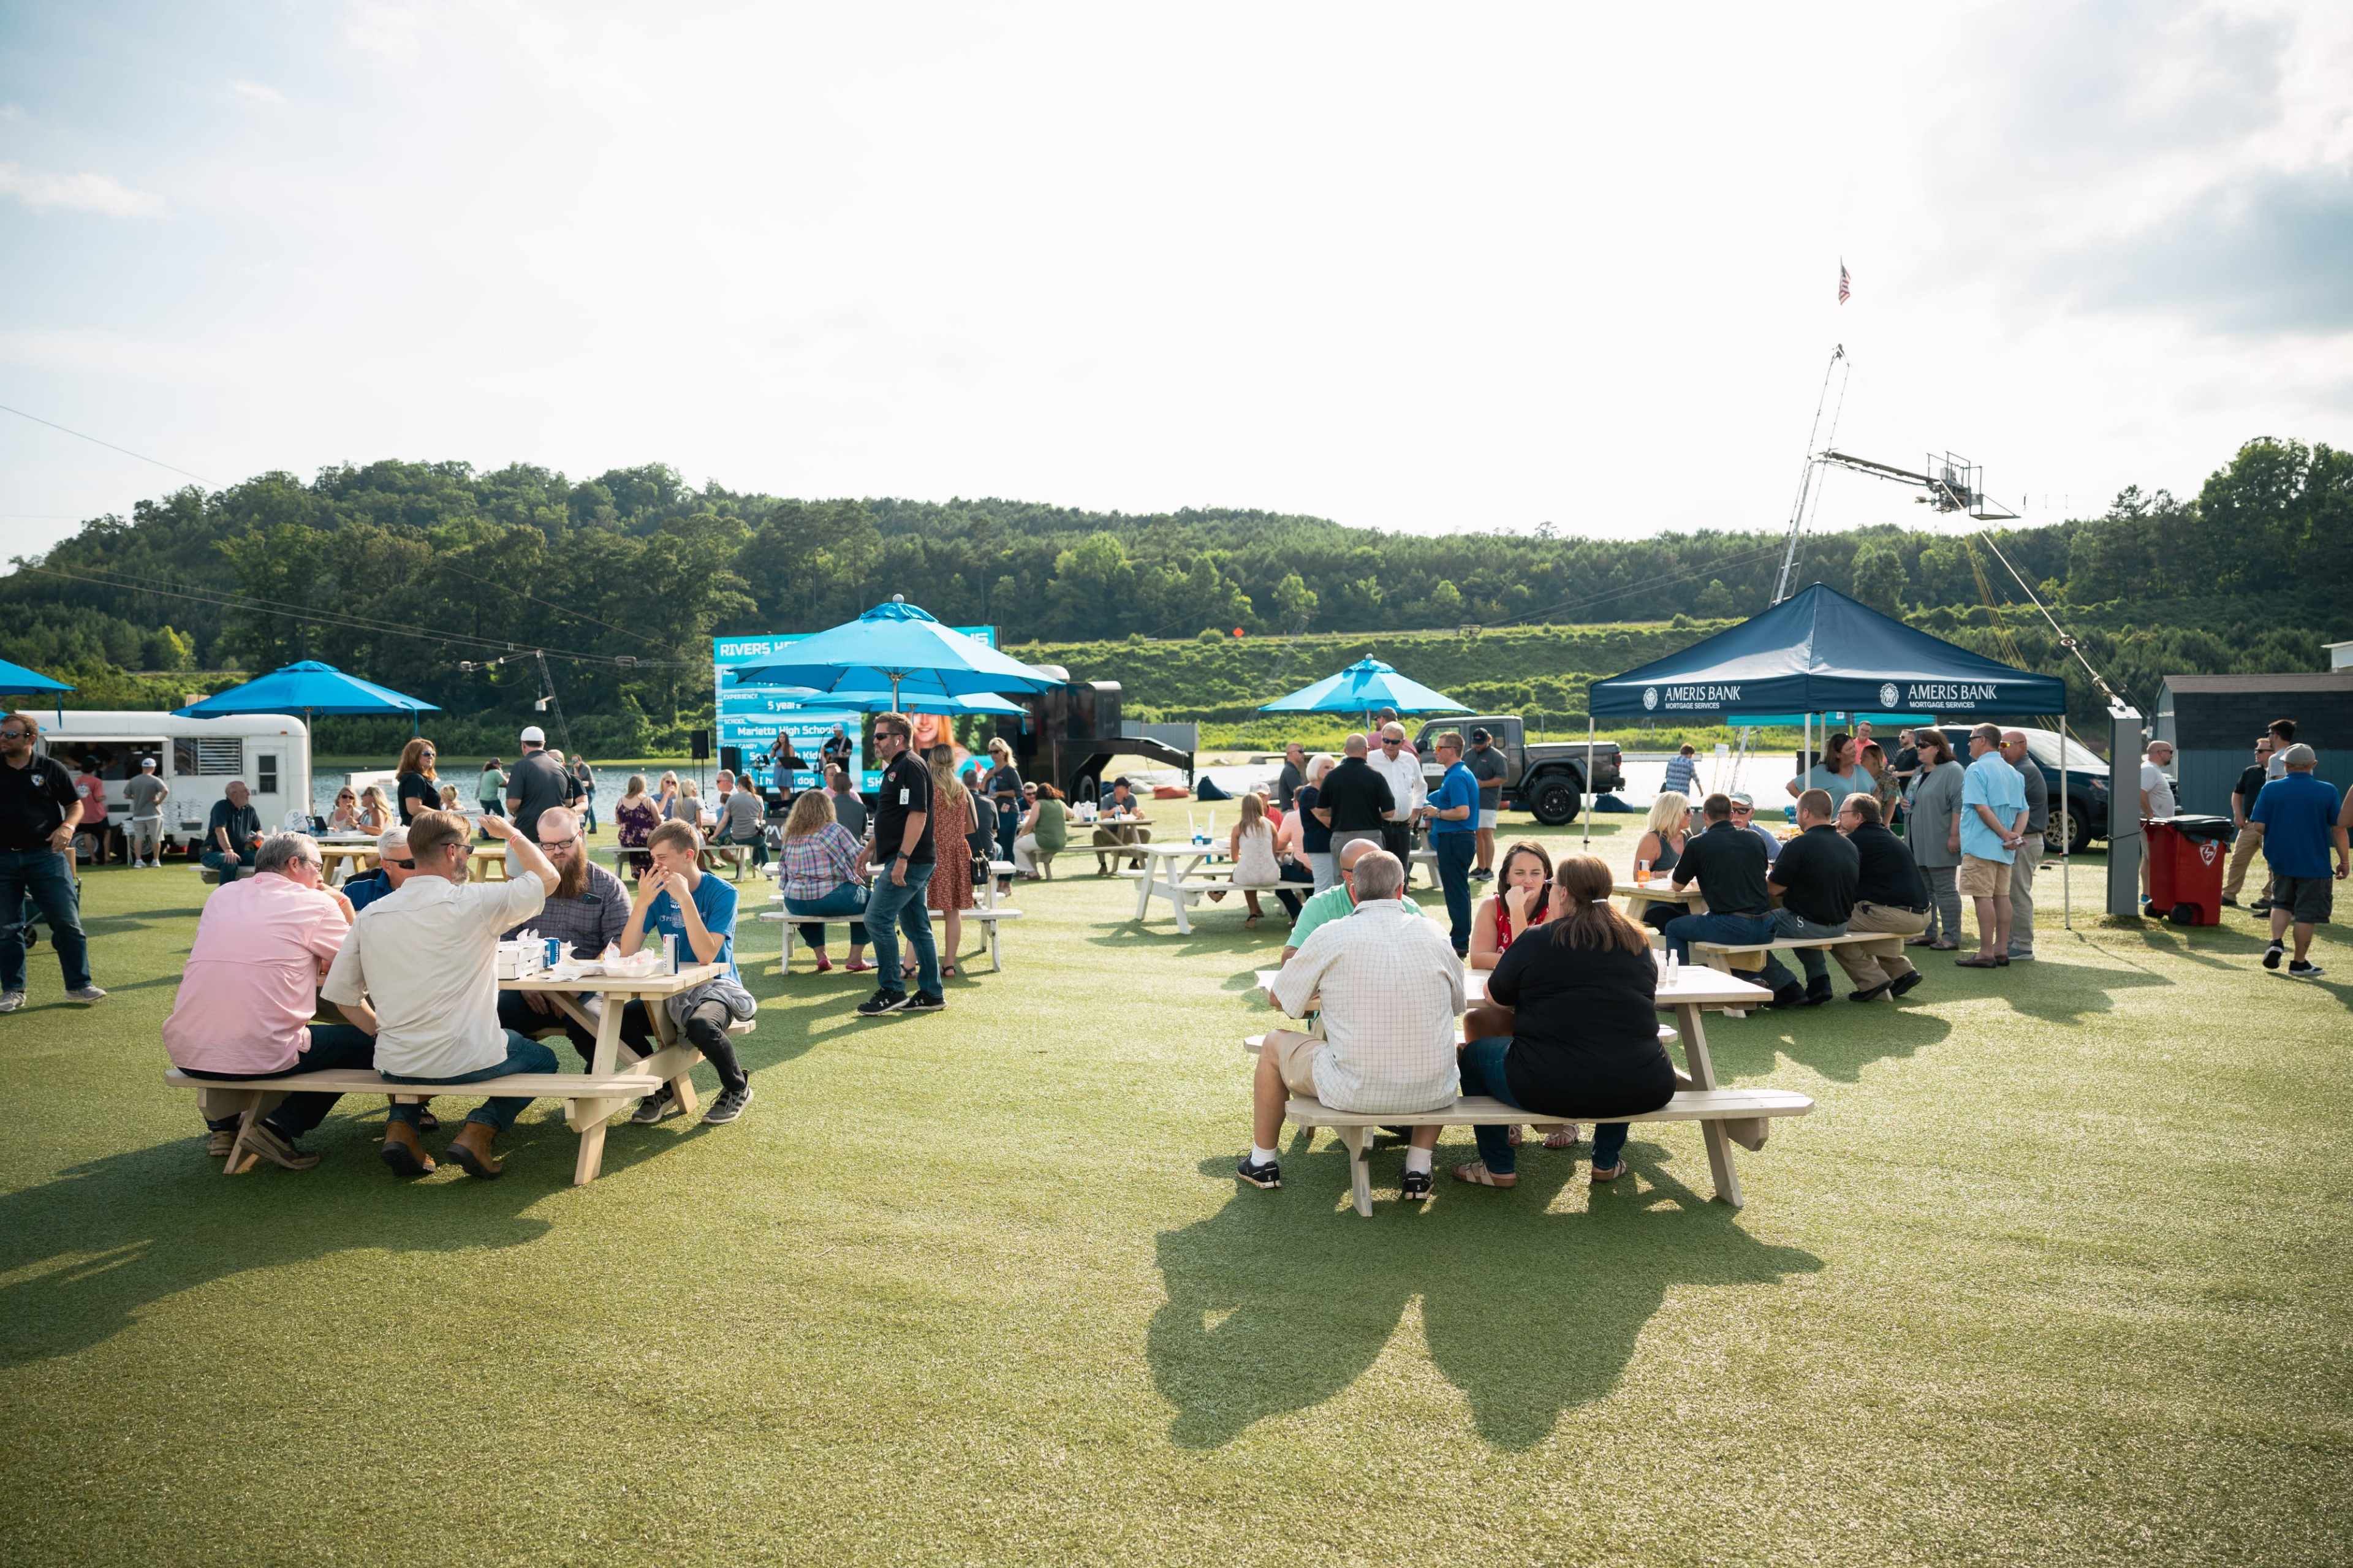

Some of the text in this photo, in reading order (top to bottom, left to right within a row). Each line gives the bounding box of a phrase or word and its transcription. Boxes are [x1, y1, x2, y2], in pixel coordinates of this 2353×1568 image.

[720, 642, 771, 656] RIVERS
[1664, 686, 1741, 701] AMERIS BANK
[1908, 684, 1997, 700] AMERIS BANK
[767, 700, 774, 710] 5
[737, 727, 776, 736] Marietta
[779, 725, 800, 737] High
[798, 775, 816, 787] dog
